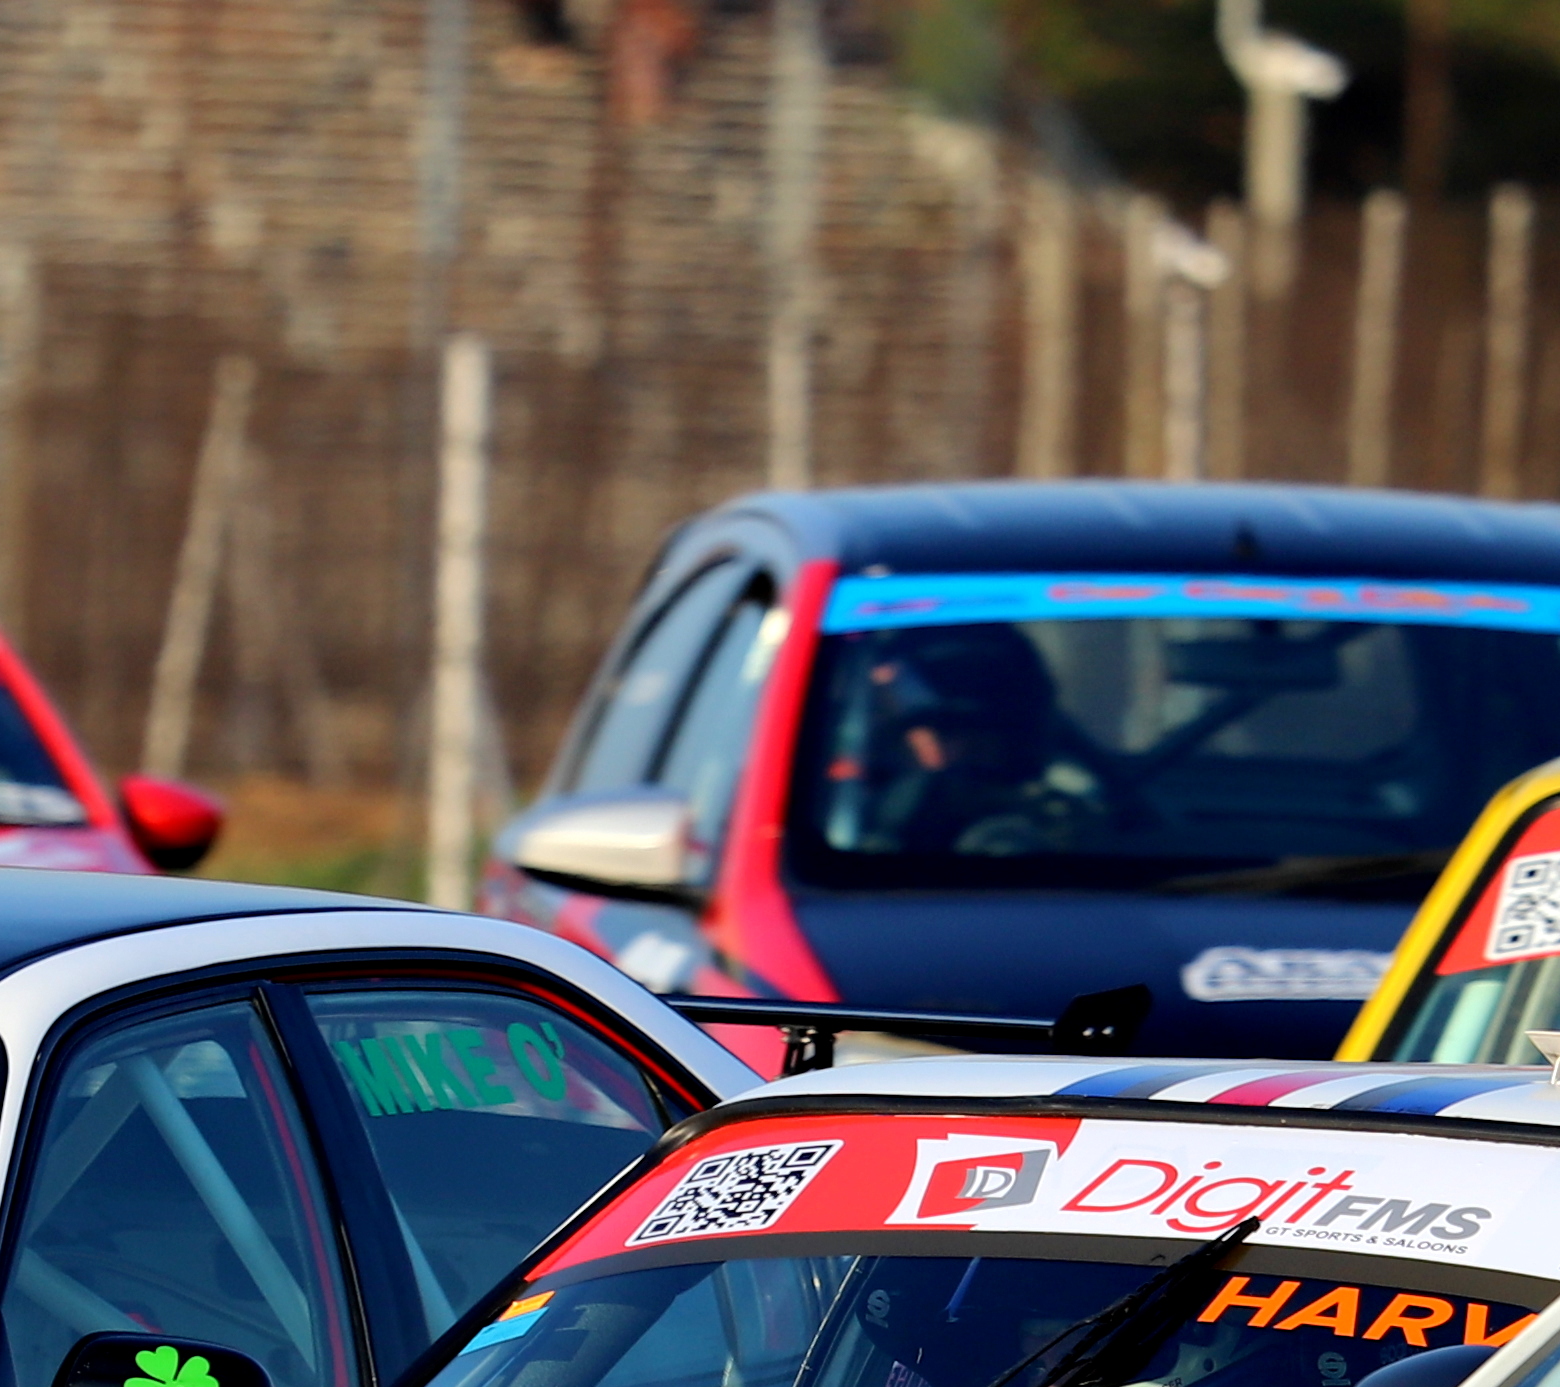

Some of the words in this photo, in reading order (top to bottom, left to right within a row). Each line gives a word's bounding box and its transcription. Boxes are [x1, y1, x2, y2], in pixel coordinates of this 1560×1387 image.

[333, 1026, 513, 1118] MIKE
[1060, 1158, 1493, 1241] DigitFMS
[1265, 1225, 1290, 1238] GT
[1291, 1227, 1364, 1245] SPORTS
[1365, 1234, 1380, 1246] &
[1382, 1237, 1470, 1256] SALOONS
